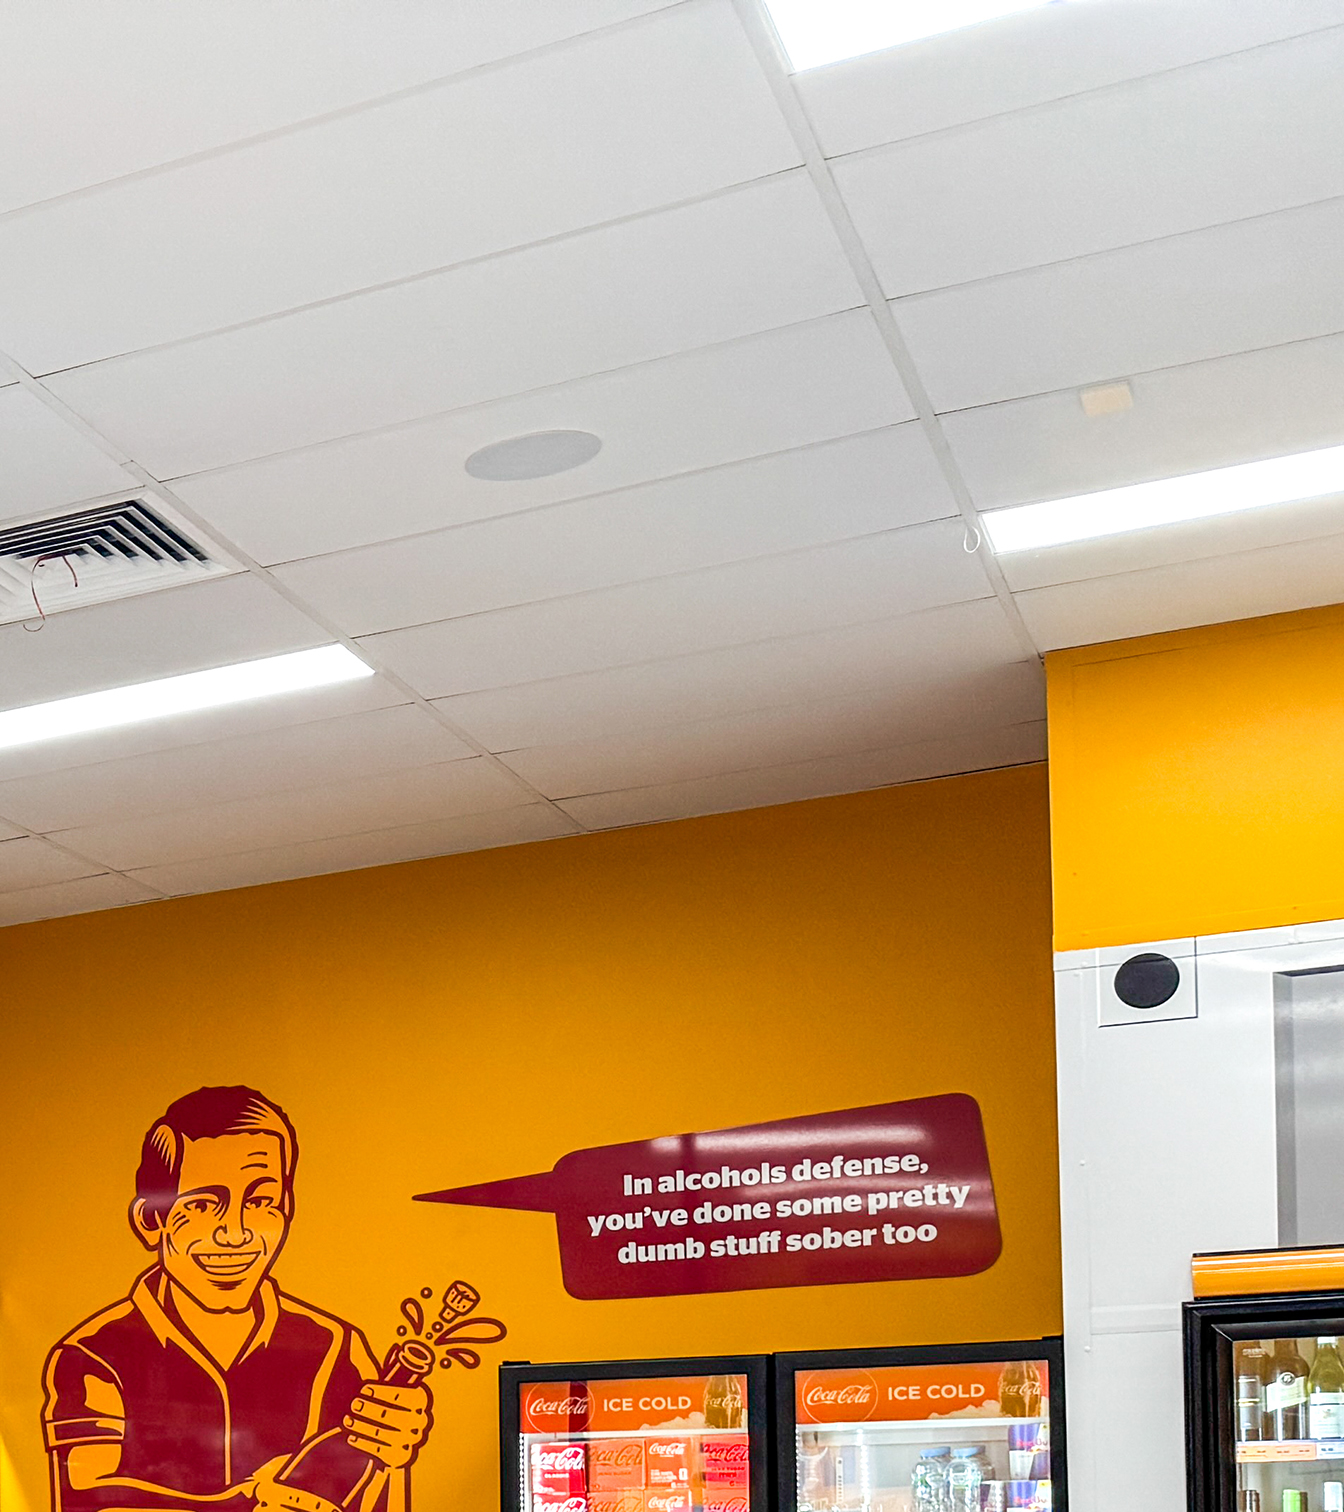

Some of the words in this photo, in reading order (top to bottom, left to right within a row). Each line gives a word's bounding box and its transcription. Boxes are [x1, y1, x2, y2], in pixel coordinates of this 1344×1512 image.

[624, 1174, 652, 1196] In
[658, 1164, 787, 1193] alcohols
[792, 1155, 929, 1182] defense,
[693, 1203, 771, 1224] done
[776, 1195, 864, 1218] some
[868, 1184, 970, 1216] pretty
[618, 1240, 706, 1264] dumb
[710, 1232, 781, 1258] stuff
[786, 1226, 878, 1252] sober
[882, 1224, 938, 1244] too
[603, 1397, 634, 1411] ICE
[640, 1395, 692, 1411] COLD
[888, 1385, 921, 1400] ICE
[928, 1383, 985, 1399] COLD
